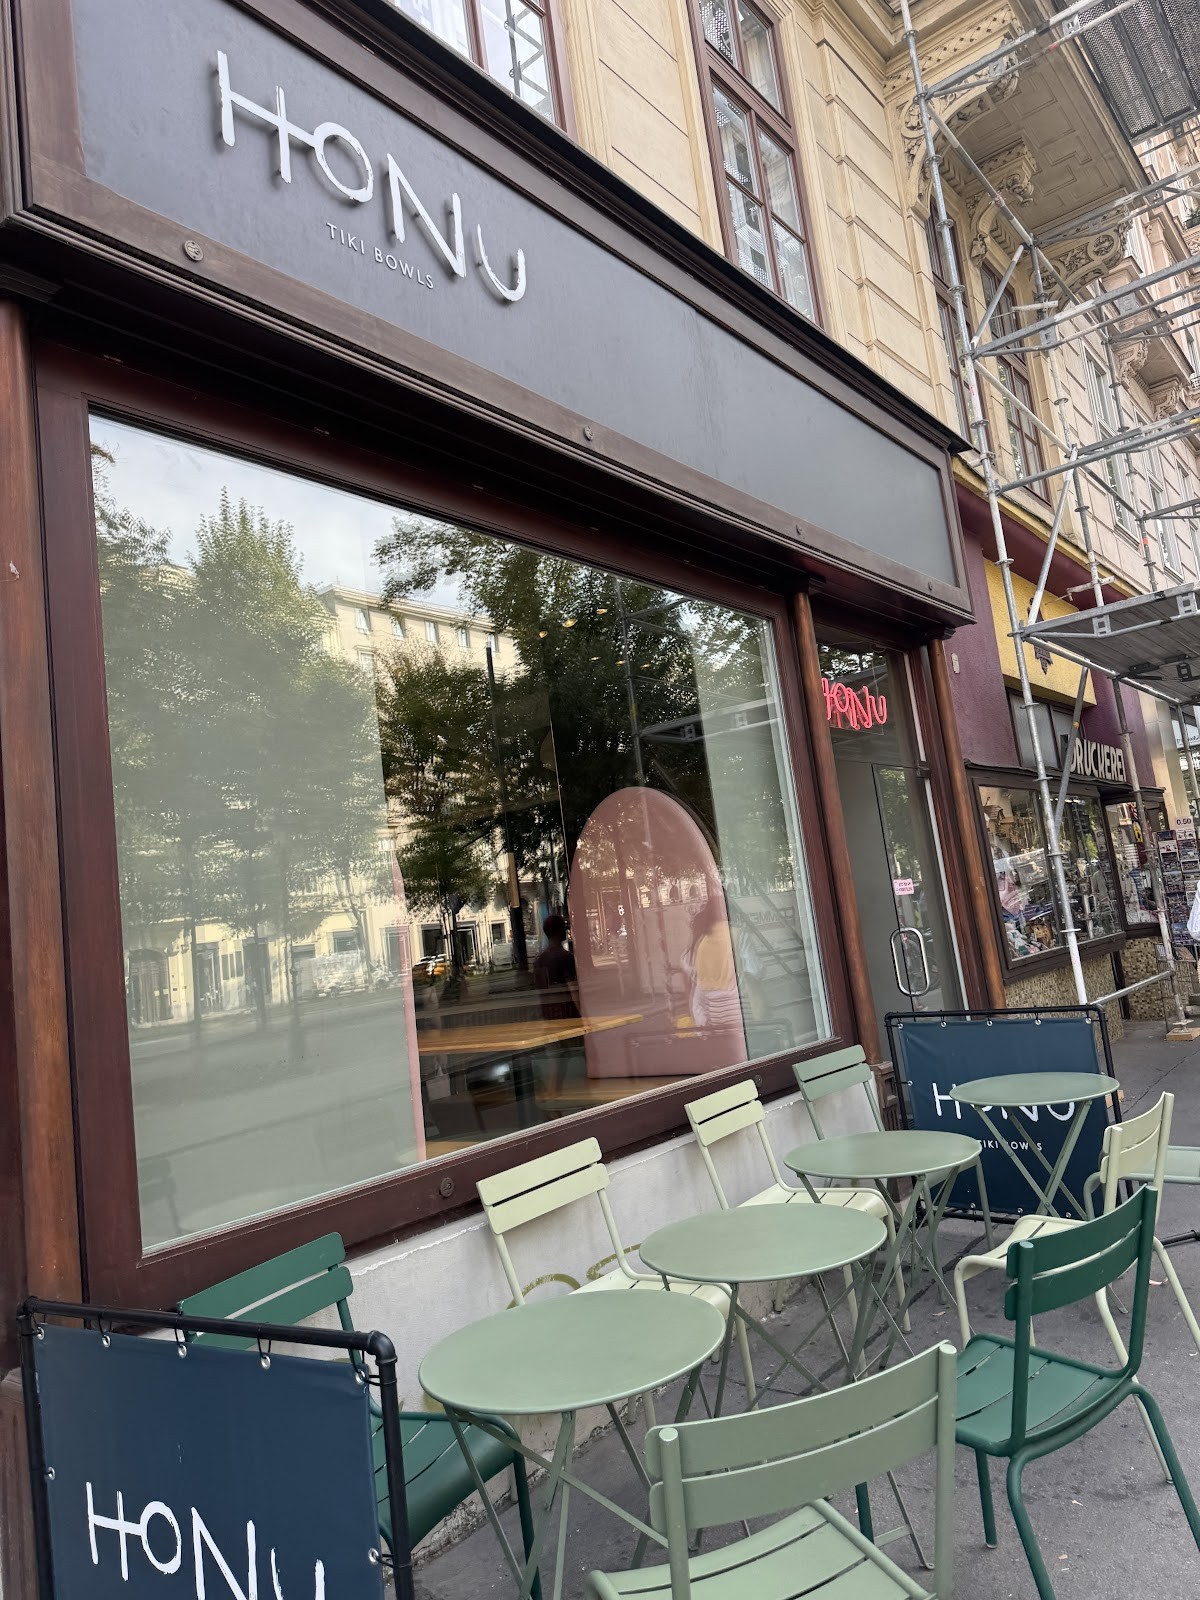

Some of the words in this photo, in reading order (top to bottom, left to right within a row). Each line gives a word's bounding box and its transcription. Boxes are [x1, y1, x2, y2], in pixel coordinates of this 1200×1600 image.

[217, 50, 527, 301] HONU
[326, 222, 365, 255] TIKI
[374, 247, 434, 289] BOWLS
[978, 1139, 999, 1149] IKI
[1006, 1140, 1043, 1151] OWS
